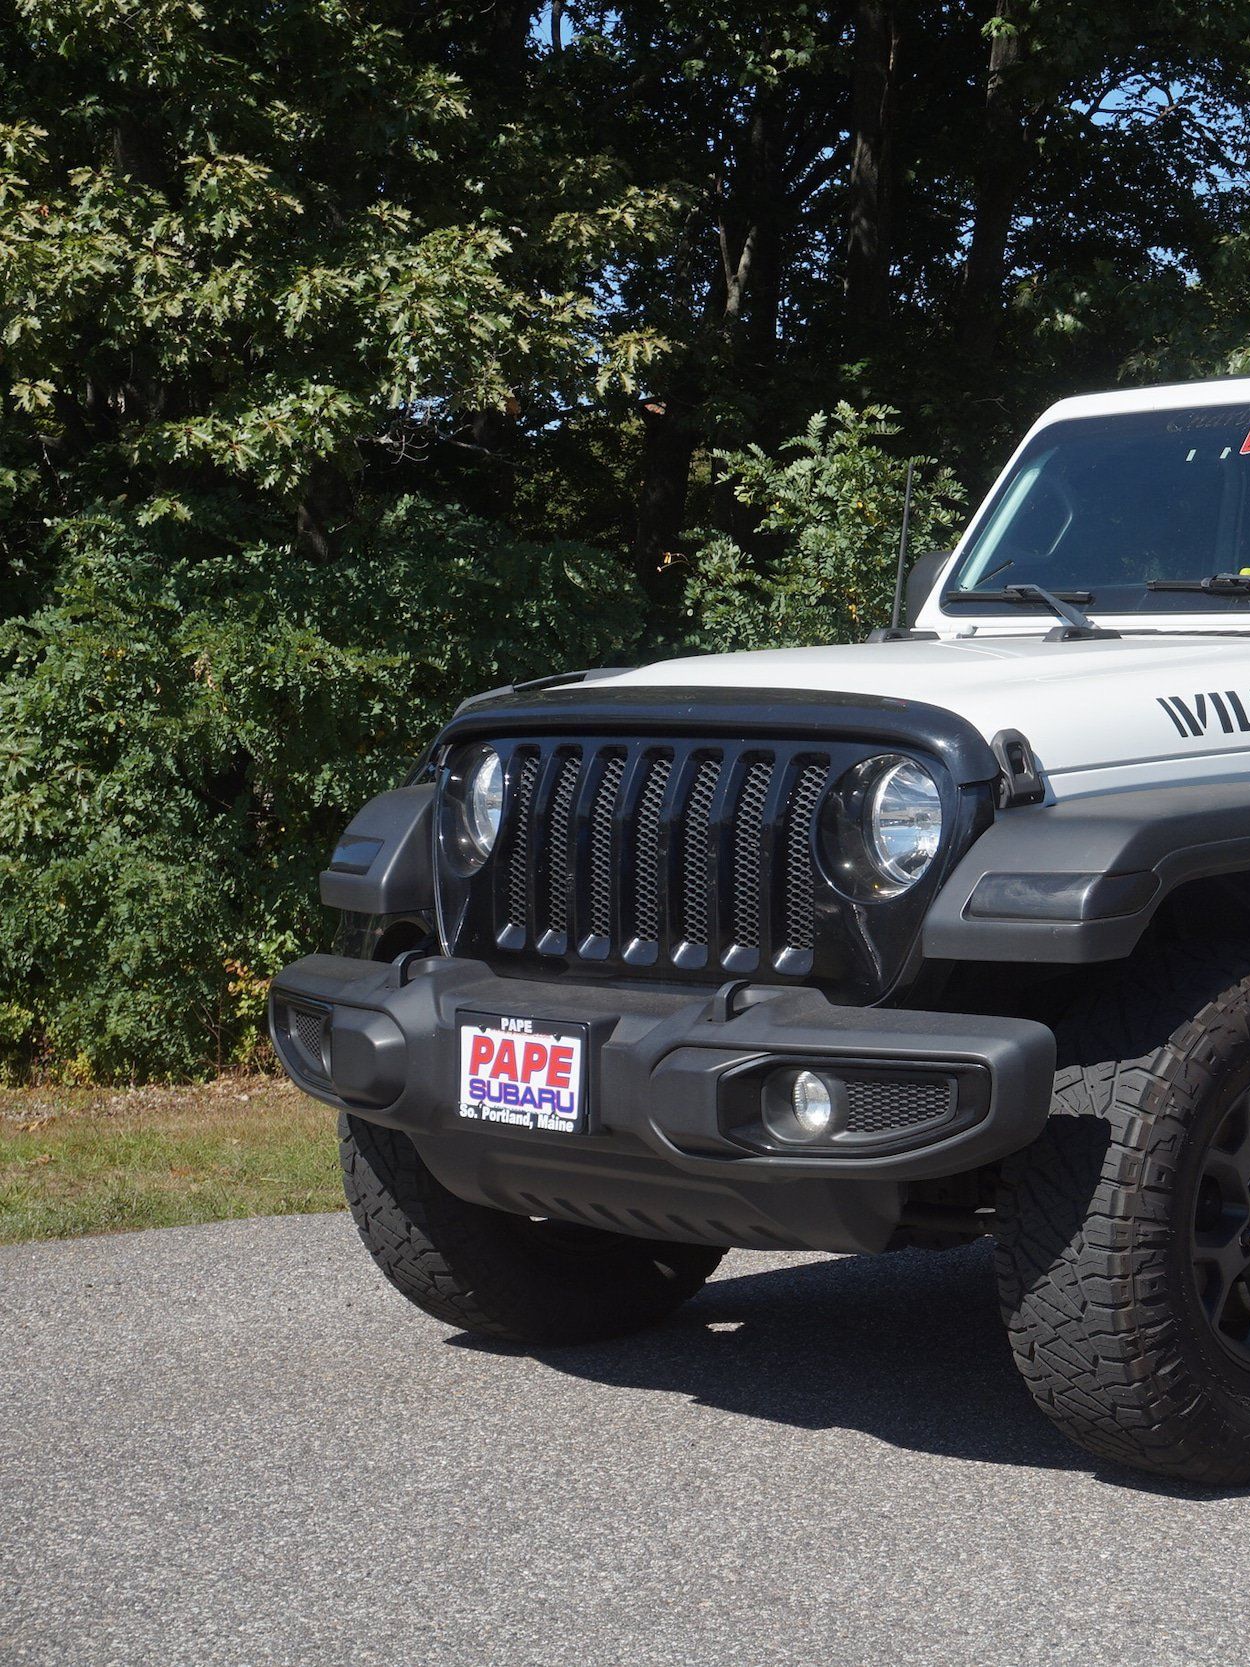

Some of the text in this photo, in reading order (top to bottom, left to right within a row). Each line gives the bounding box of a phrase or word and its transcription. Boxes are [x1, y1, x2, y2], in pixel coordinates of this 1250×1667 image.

[501, 1018, 533, 1033] PAPE
[469, 1035, 574, 1089] PAPE
[469, 1078, 574, 1113] SUBARU
[459, 1103, 574, 1133] So. Portland, Maine
